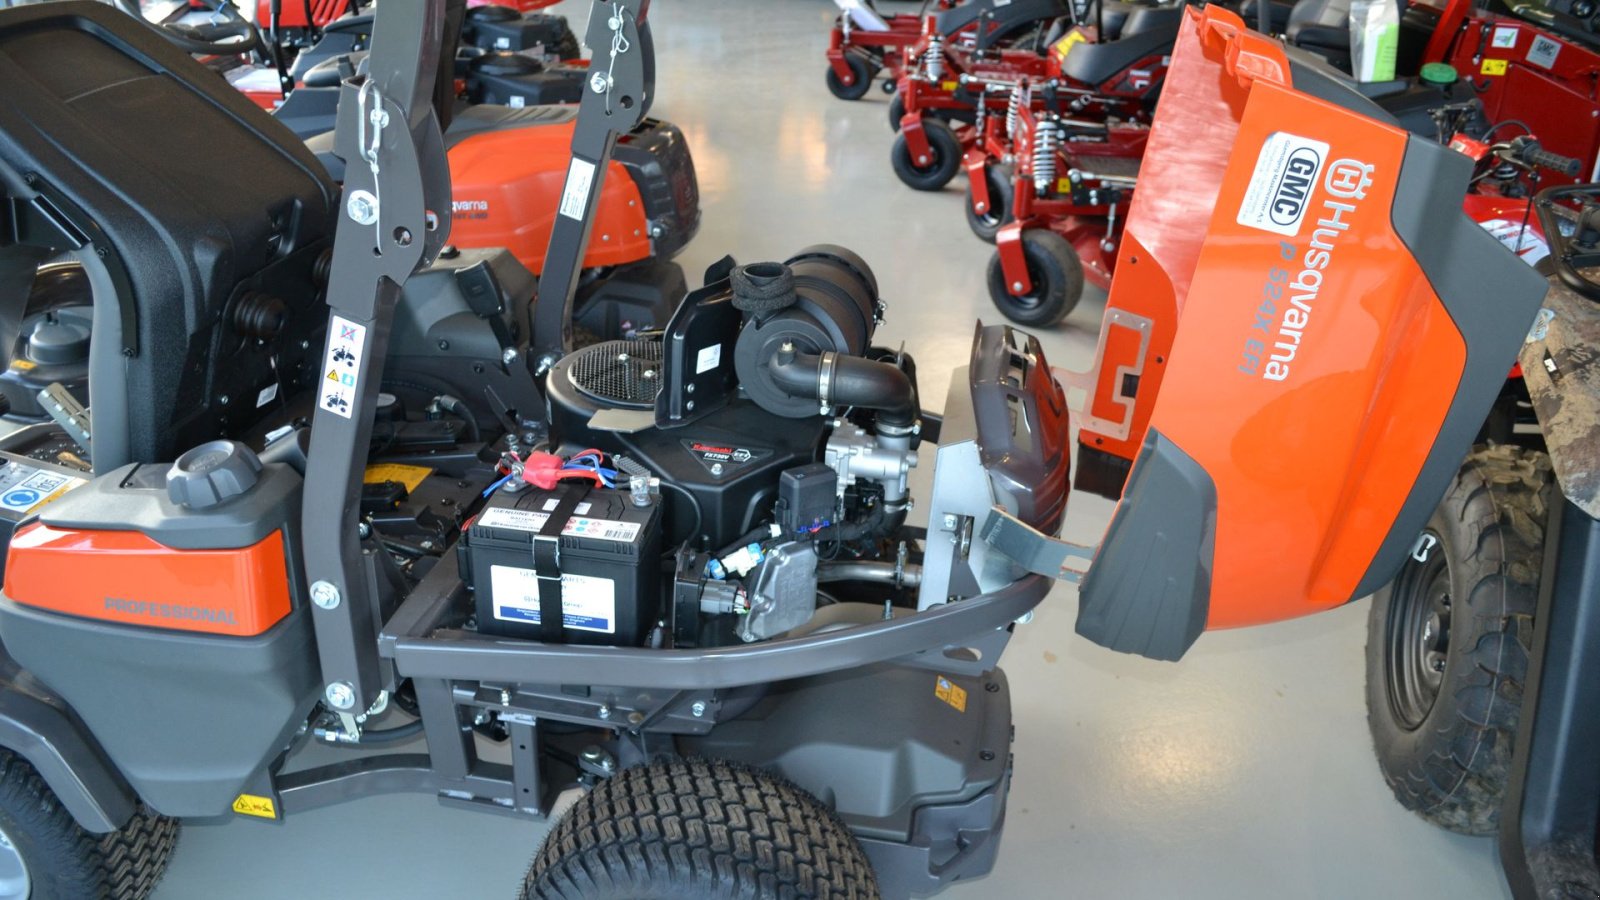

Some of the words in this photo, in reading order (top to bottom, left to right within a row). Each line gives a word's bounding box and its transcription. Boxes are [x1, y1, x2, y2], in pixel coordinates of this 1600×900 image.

[1274, 157, 1315, 216] GMC
[451, 200, 488, 213] qvarna
[1279, 240, 1297, 261] P
[1252, 266, 1289, 333] 524X
[1263, 199, 1357, 381] Husqvarna
[1238, 337, 1266, 376] EFI
[493, 508, 530, 517] GENUINE
[104, 597, 238, 625] PROFESSIONAL
